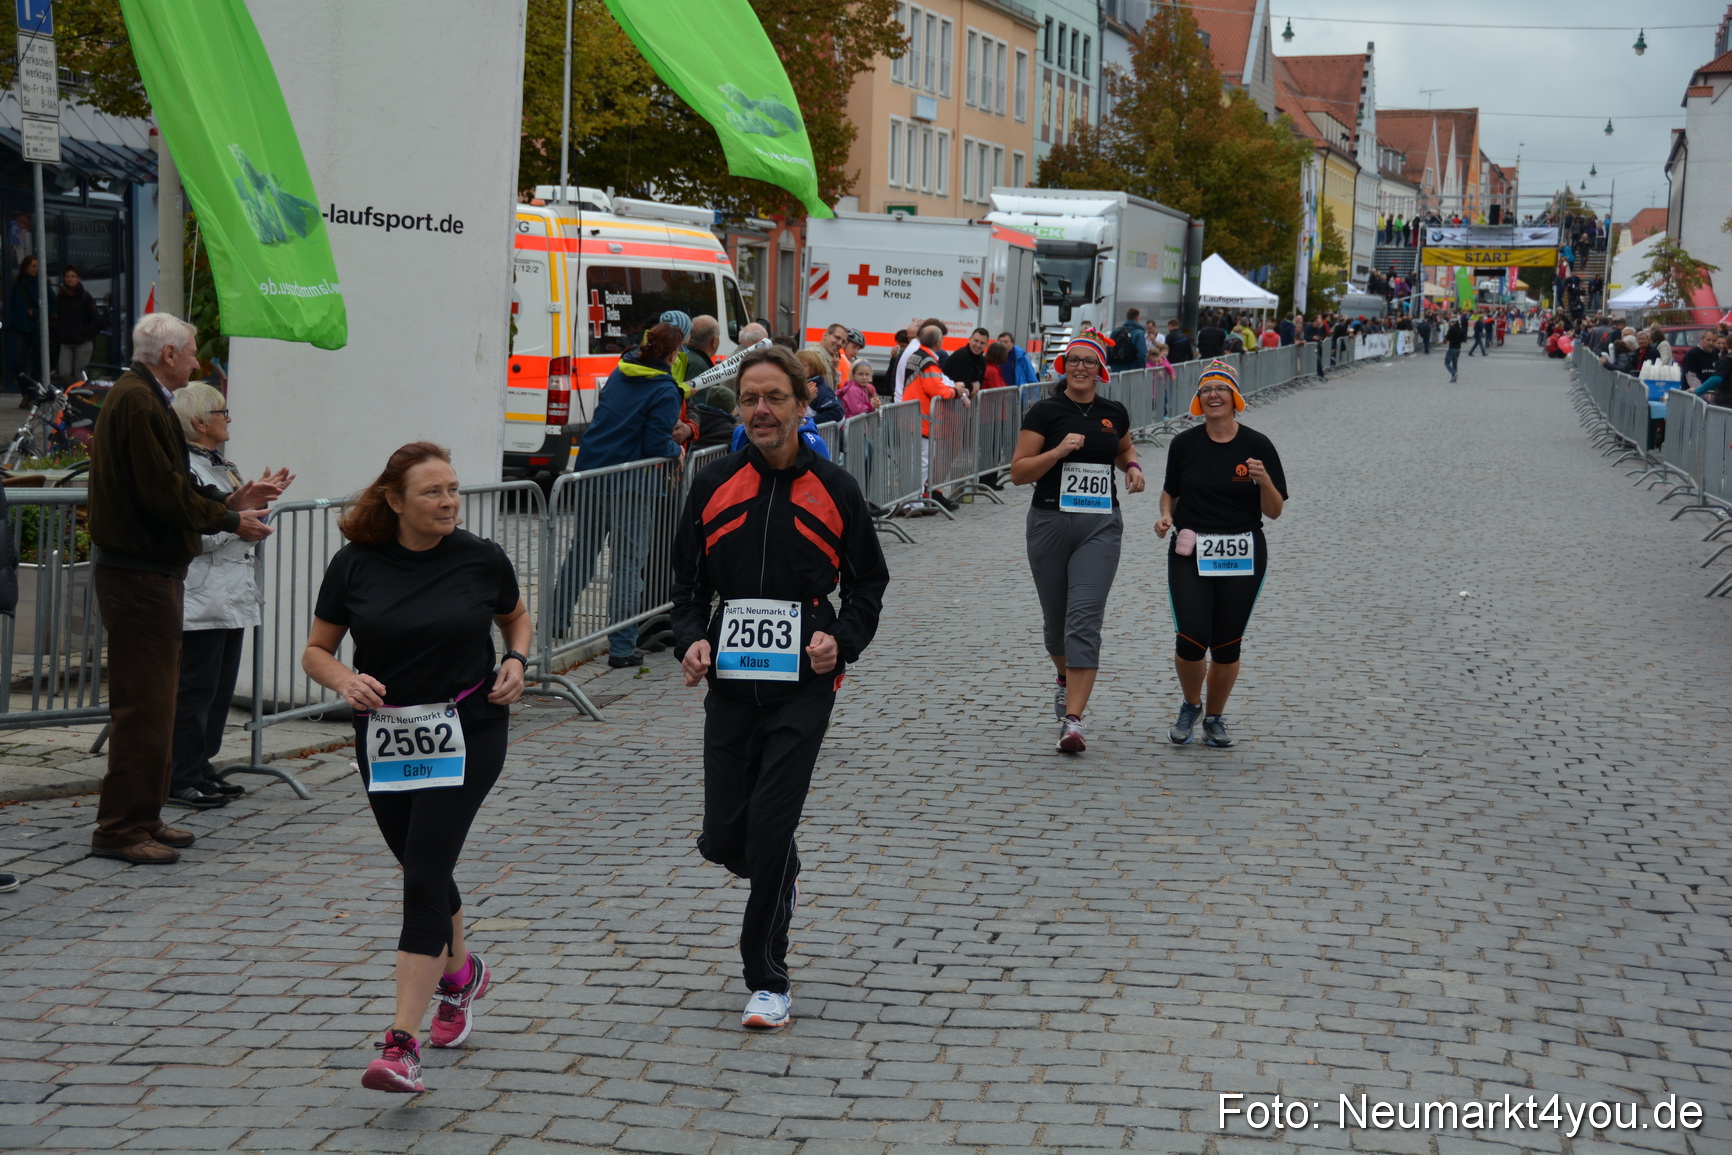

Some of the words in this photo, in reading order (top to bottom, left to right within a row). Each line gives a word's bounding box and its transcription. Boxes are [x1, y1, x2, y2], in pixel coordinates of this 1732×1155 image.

[38, 44, 48, 54] mit
[25, 68, 52, 83] werktags
[23, 82, 39, 94] Mo-Fr
[1465, 252, 1511, 263] START
[885, 265, 944, 278] Bayerisches
[884, 278, 912, 288] Rotes
[605, 291, 633, 307] Bayerisches
[883, 290, 911, 300] Kreuz
[1203, 295, 1244, 305] Laufsport
[606, 307, 621, 321] Rotes
[1067, 475, 1108, 495] 2460
[1073, 498, 1101, 507] Stefanie
[1202, 538, 1248, 556] 2459
[1212, 561, 1238, 569] Sandra
[725, 607, 745, 615] PARTL
[746, 607, 786, 616] Neumarkt
[726, 619, 792, 649] 2563
[740, 656, 770, 668] Klaus
[371, 713, 396, 724] PARTL
[397, 712, 442, 724] Neumarkt
[375, 723, 457, 757] 2562
[403, 763, 434, 778] Gaby
